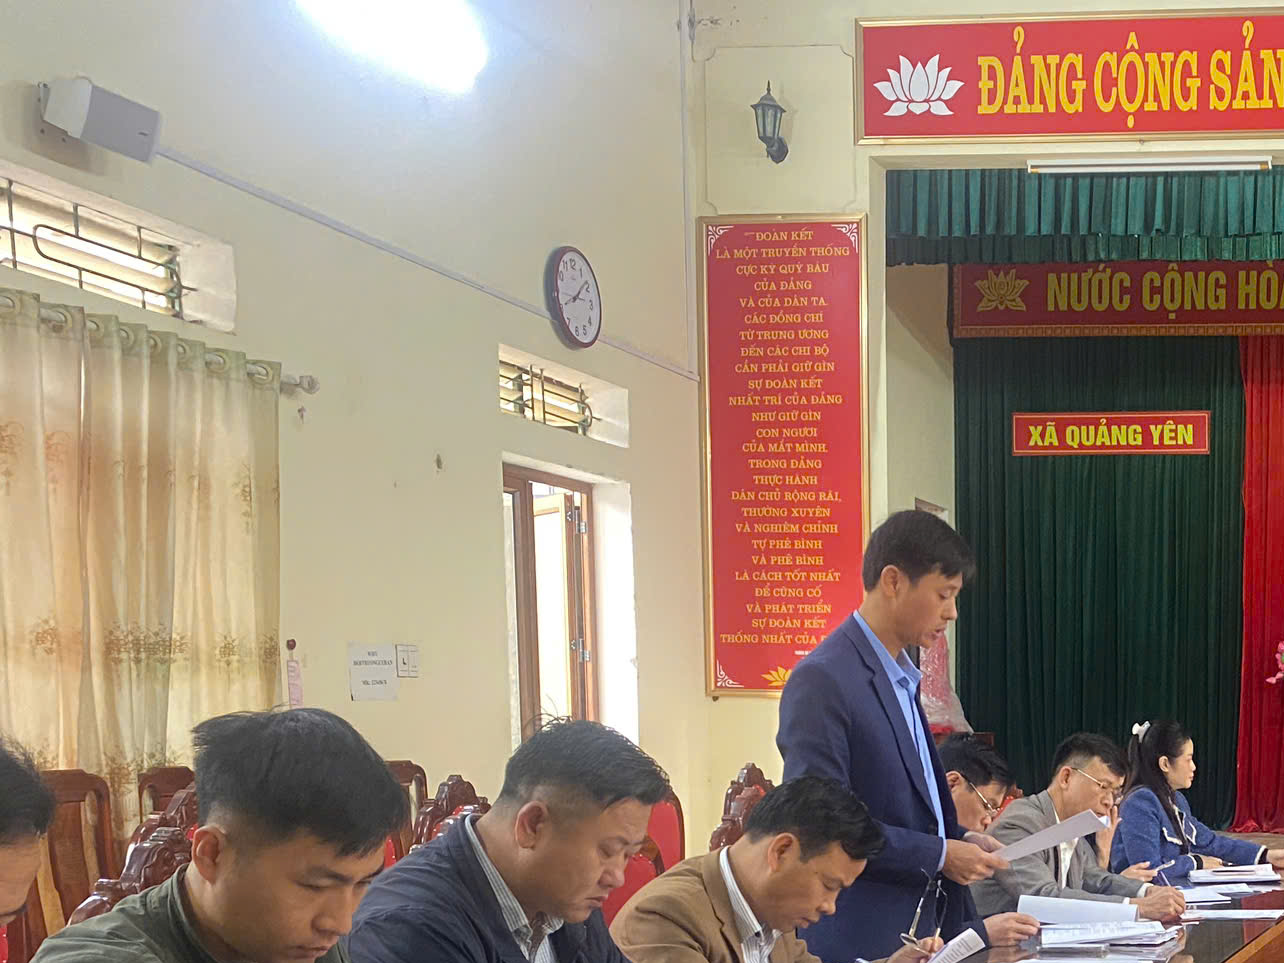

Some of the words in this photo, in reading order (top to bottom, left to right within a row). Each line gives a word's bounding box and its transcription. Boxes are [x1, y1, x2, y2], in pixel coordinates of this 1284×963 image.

[977, 26, 1084, 114] ĐẢNG
[1094, 31, 1200, 128] CỘNG
[569, 258, 576, 270] 12
[580, 268, 583, 279] 1
[1047, 264, 1130, 311] NƯỚC
[1143, 262, 1226, 319] CỘNG
[590, 300, 593, 310] 3
[575, 326, 579, 336] 6
[583, 325, 586, 336] 5
[757, 331, 794, 340] TRUNG
[792, 347, 810, 355] CHI
[1029, 422, 1058, 446] XÃ
[1066, 419, 1145, 446] QUẢNG
[1150, 420, 1194, 445] YÊN
[748, 459, 786, 468] TRONG
[791, 456, 822, 468] ĐẢNG
